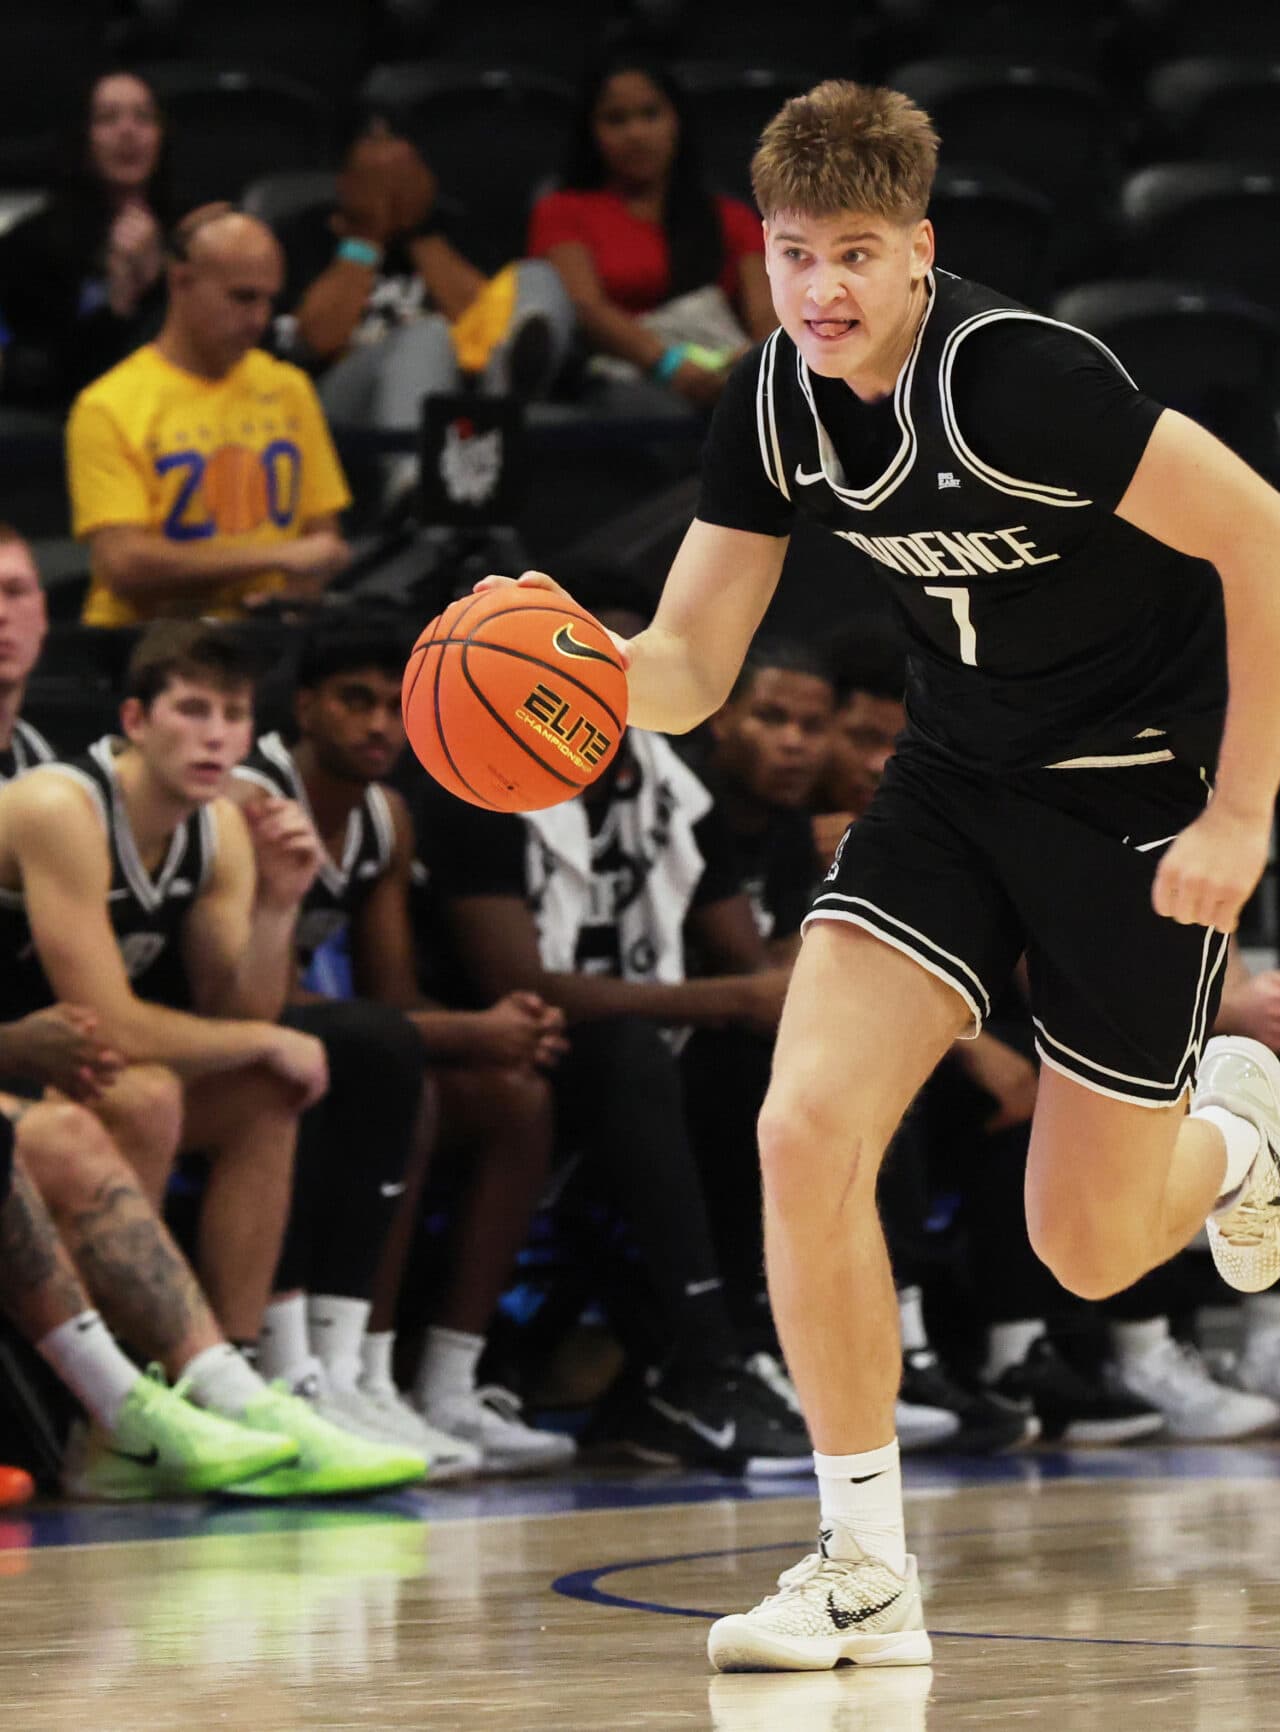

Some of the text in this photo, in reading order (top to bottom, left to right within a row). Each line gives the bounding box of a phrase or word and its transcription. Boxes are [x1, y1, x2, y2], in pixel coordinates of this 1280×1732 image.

[832, 525, 1061, 577] OVIDENCE
[923, 586, 977, 667] 7
[515, 708, 593, 774] CHAMPIONS
[523, 682, 612, 766] ELITE
